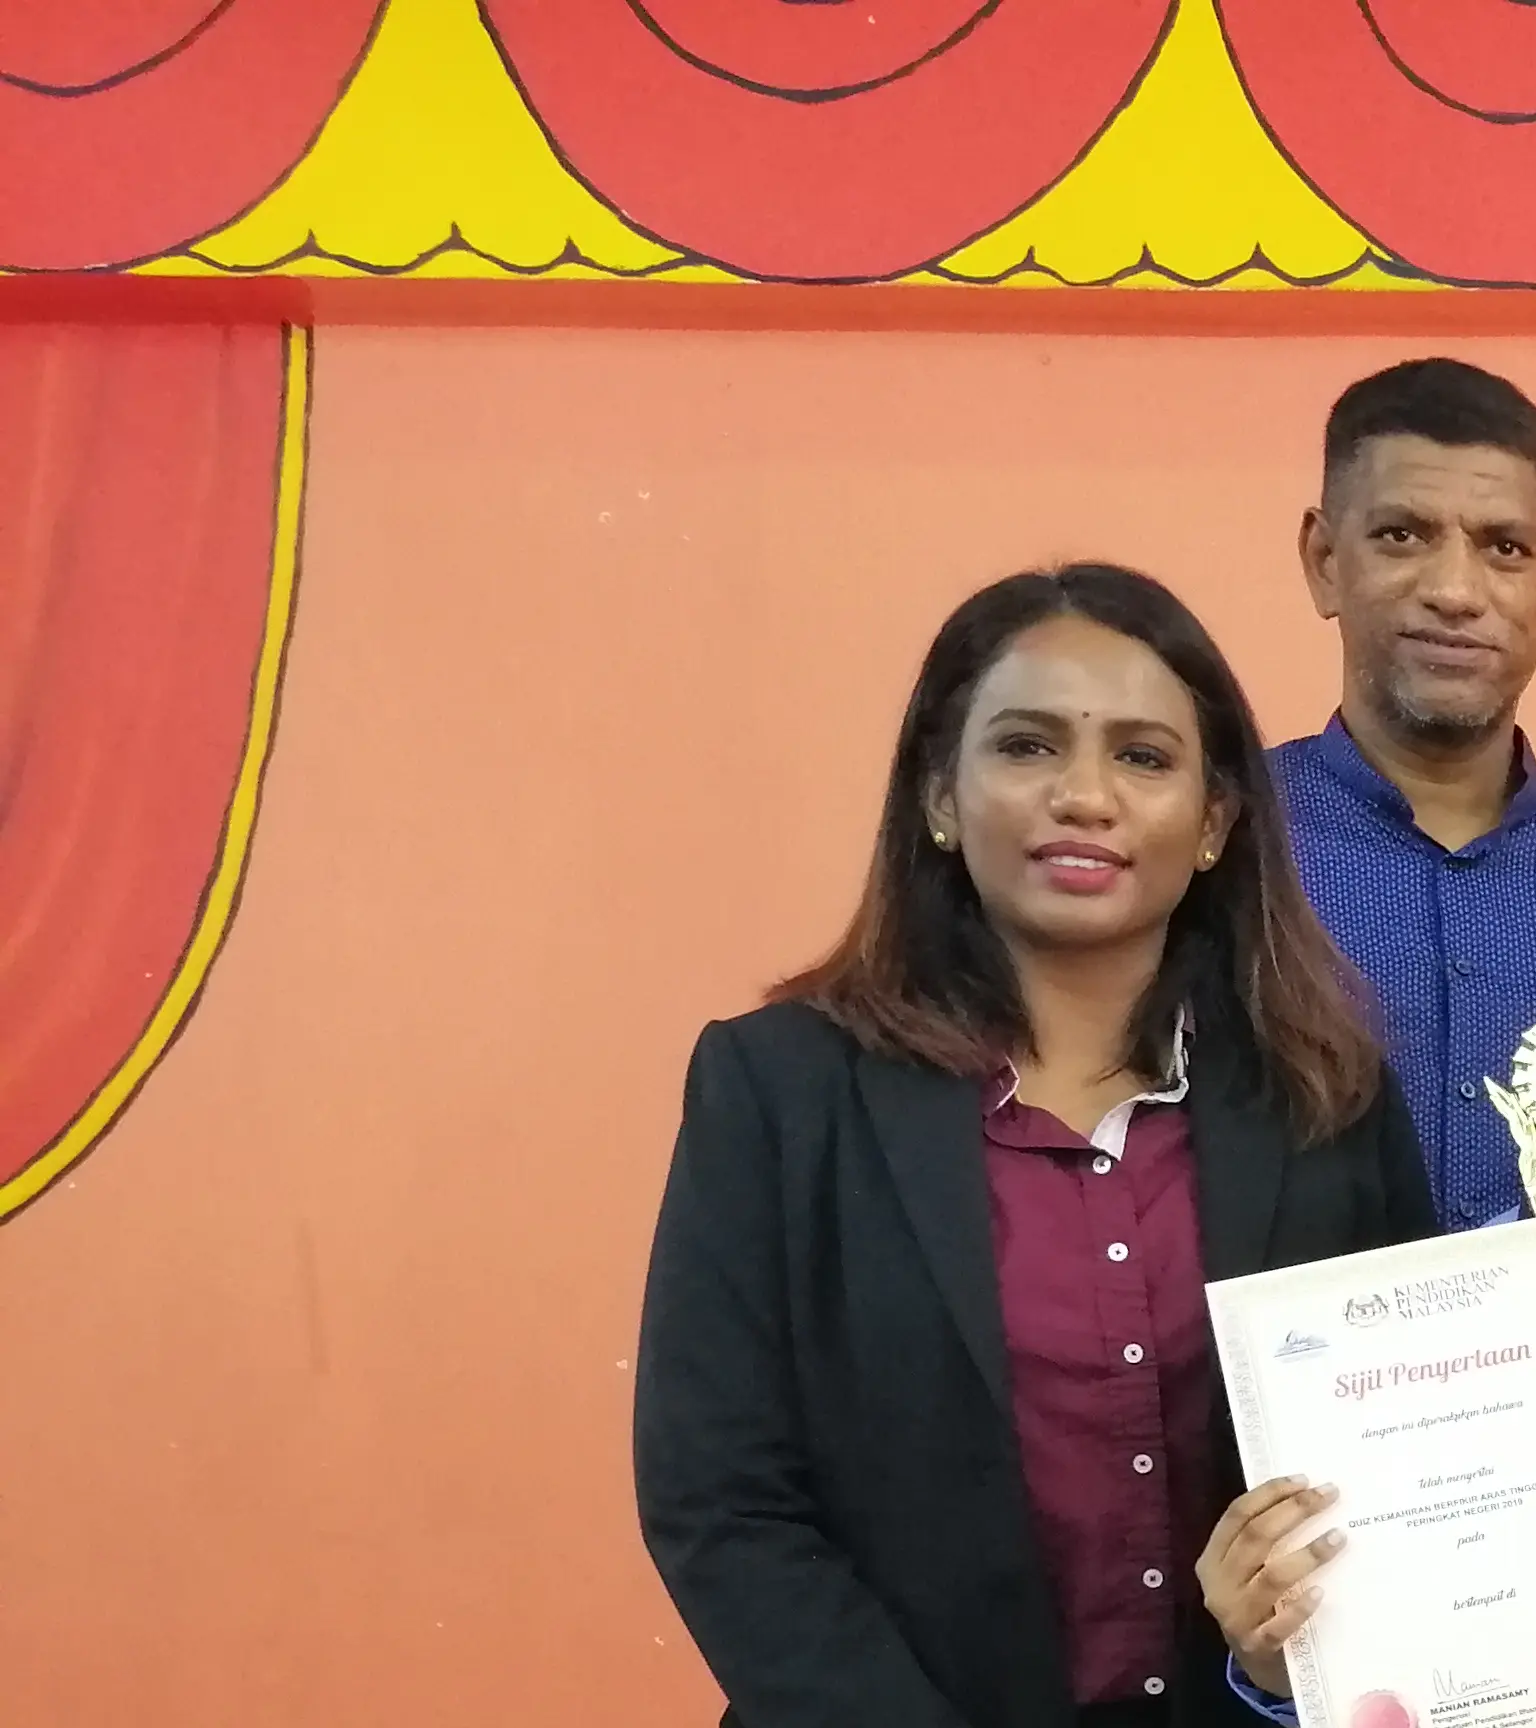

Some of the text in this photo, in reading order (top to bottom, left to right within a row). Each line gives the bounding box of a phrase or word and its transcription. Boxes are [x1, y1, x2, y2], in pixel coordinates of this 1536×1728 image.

[1393, 1266, 1508, 1297] KEMENTERIAN
[1396, 1281, 1494, 1309] PENDIDIKAN
[1398, 1295, 1481, 1319] MALAYSIA
[1334, 1344, 1532, 1400] Sijil Penyertaan
